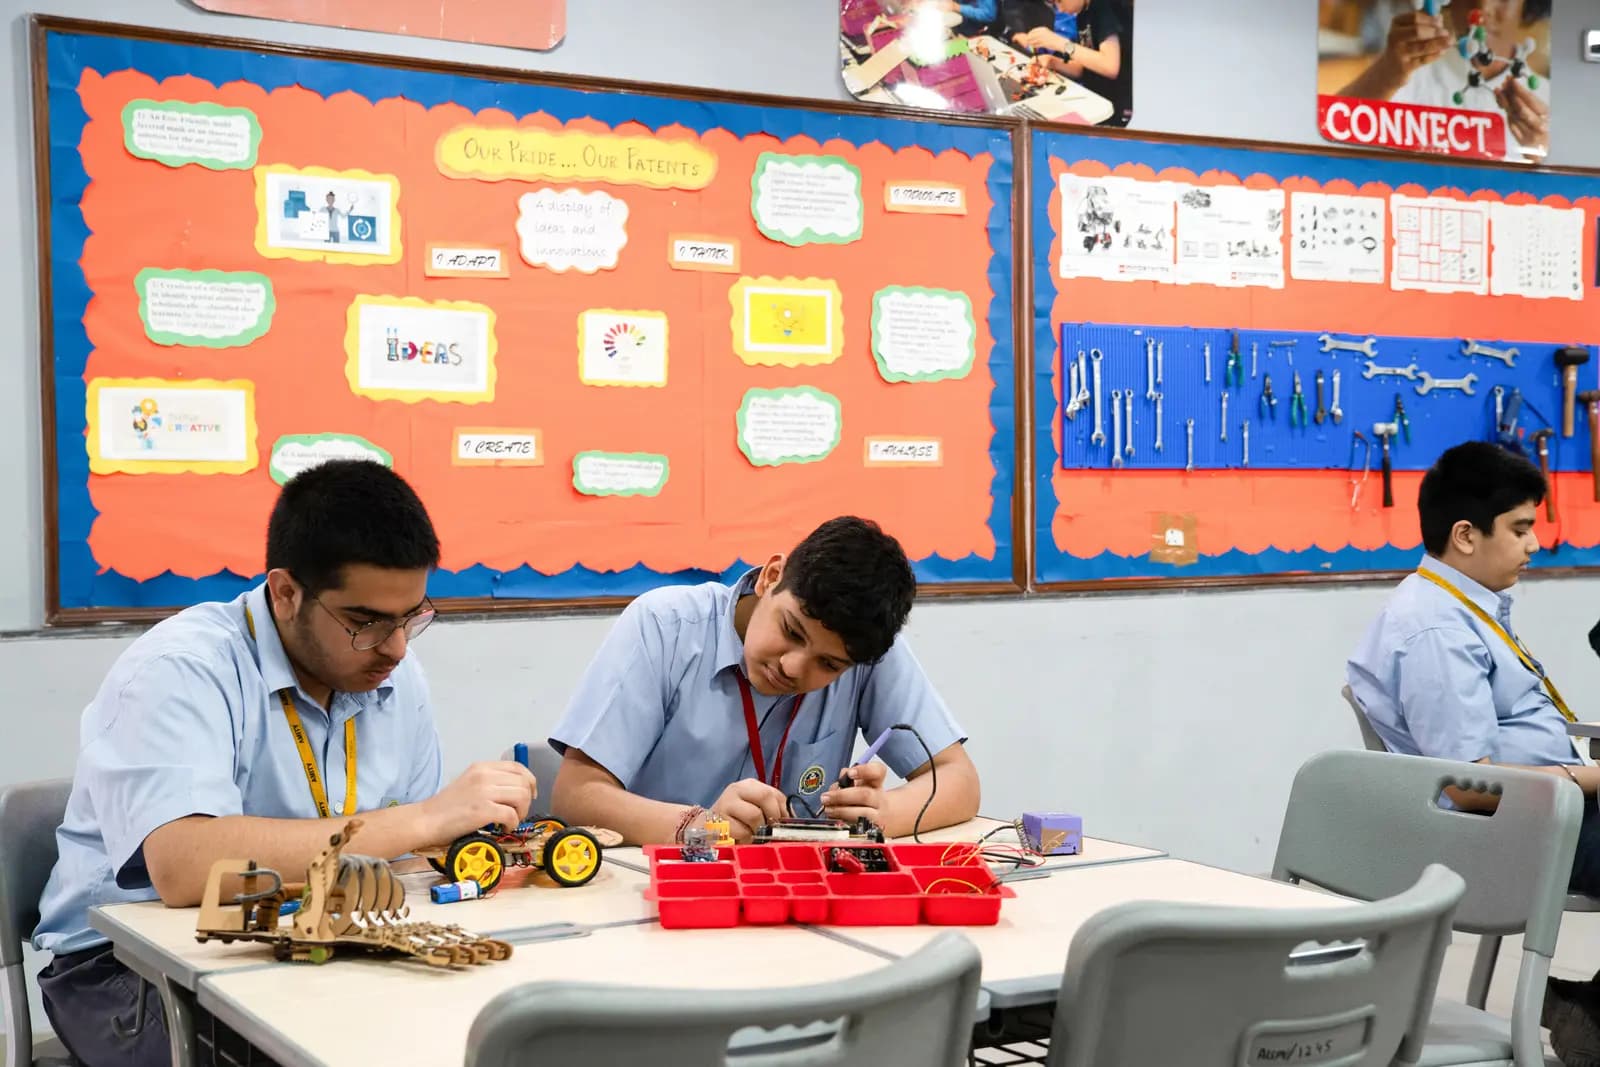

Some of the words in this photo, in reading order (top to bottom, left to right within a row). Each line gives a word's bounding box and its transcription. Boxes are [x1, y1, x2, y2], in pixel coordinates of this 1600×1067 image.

[1327, 102, 1492, 152] CONNECT
[547, 199, 593, 218] display
[600, 200, 613, 217] of
[572, 221, 596, 236] and
[447, 254, 497, 268] ADAPT
[689, 246, 729, 260] THINK
[386, 334, 463, 366] IDEAS
[474, 440, 532, 454] CREATE
[292, 724, 305, 744] AMITY
[305, 762, 318, 783] AMITY
